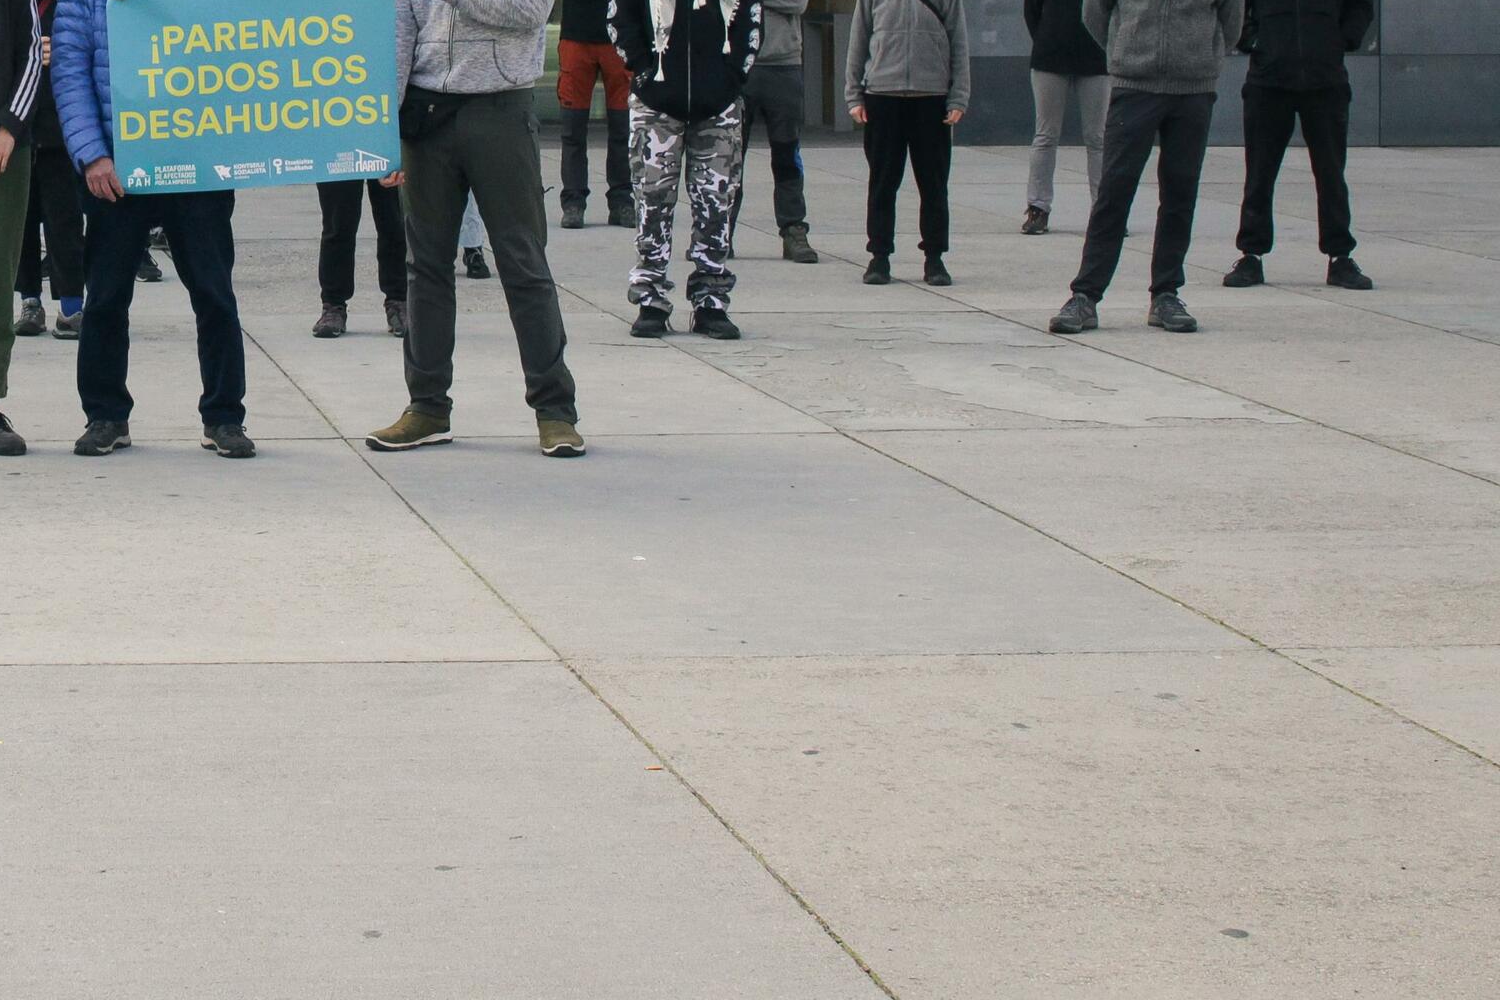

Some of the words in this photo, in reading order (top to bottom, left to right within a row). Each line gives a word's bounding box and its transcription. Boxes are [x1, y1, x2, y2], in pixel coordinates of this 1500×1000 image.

[150, 14, 355, 64] ¡PAREMOS
[138, 60, 280, 98] TODOS
[291, 54, 367, 88] LOS
[119, 94, 389, 141] DESAHUCIOS!
[127, 177, 151, 188] PAH
[154, 164, 196, 173] PLATAFORMA
